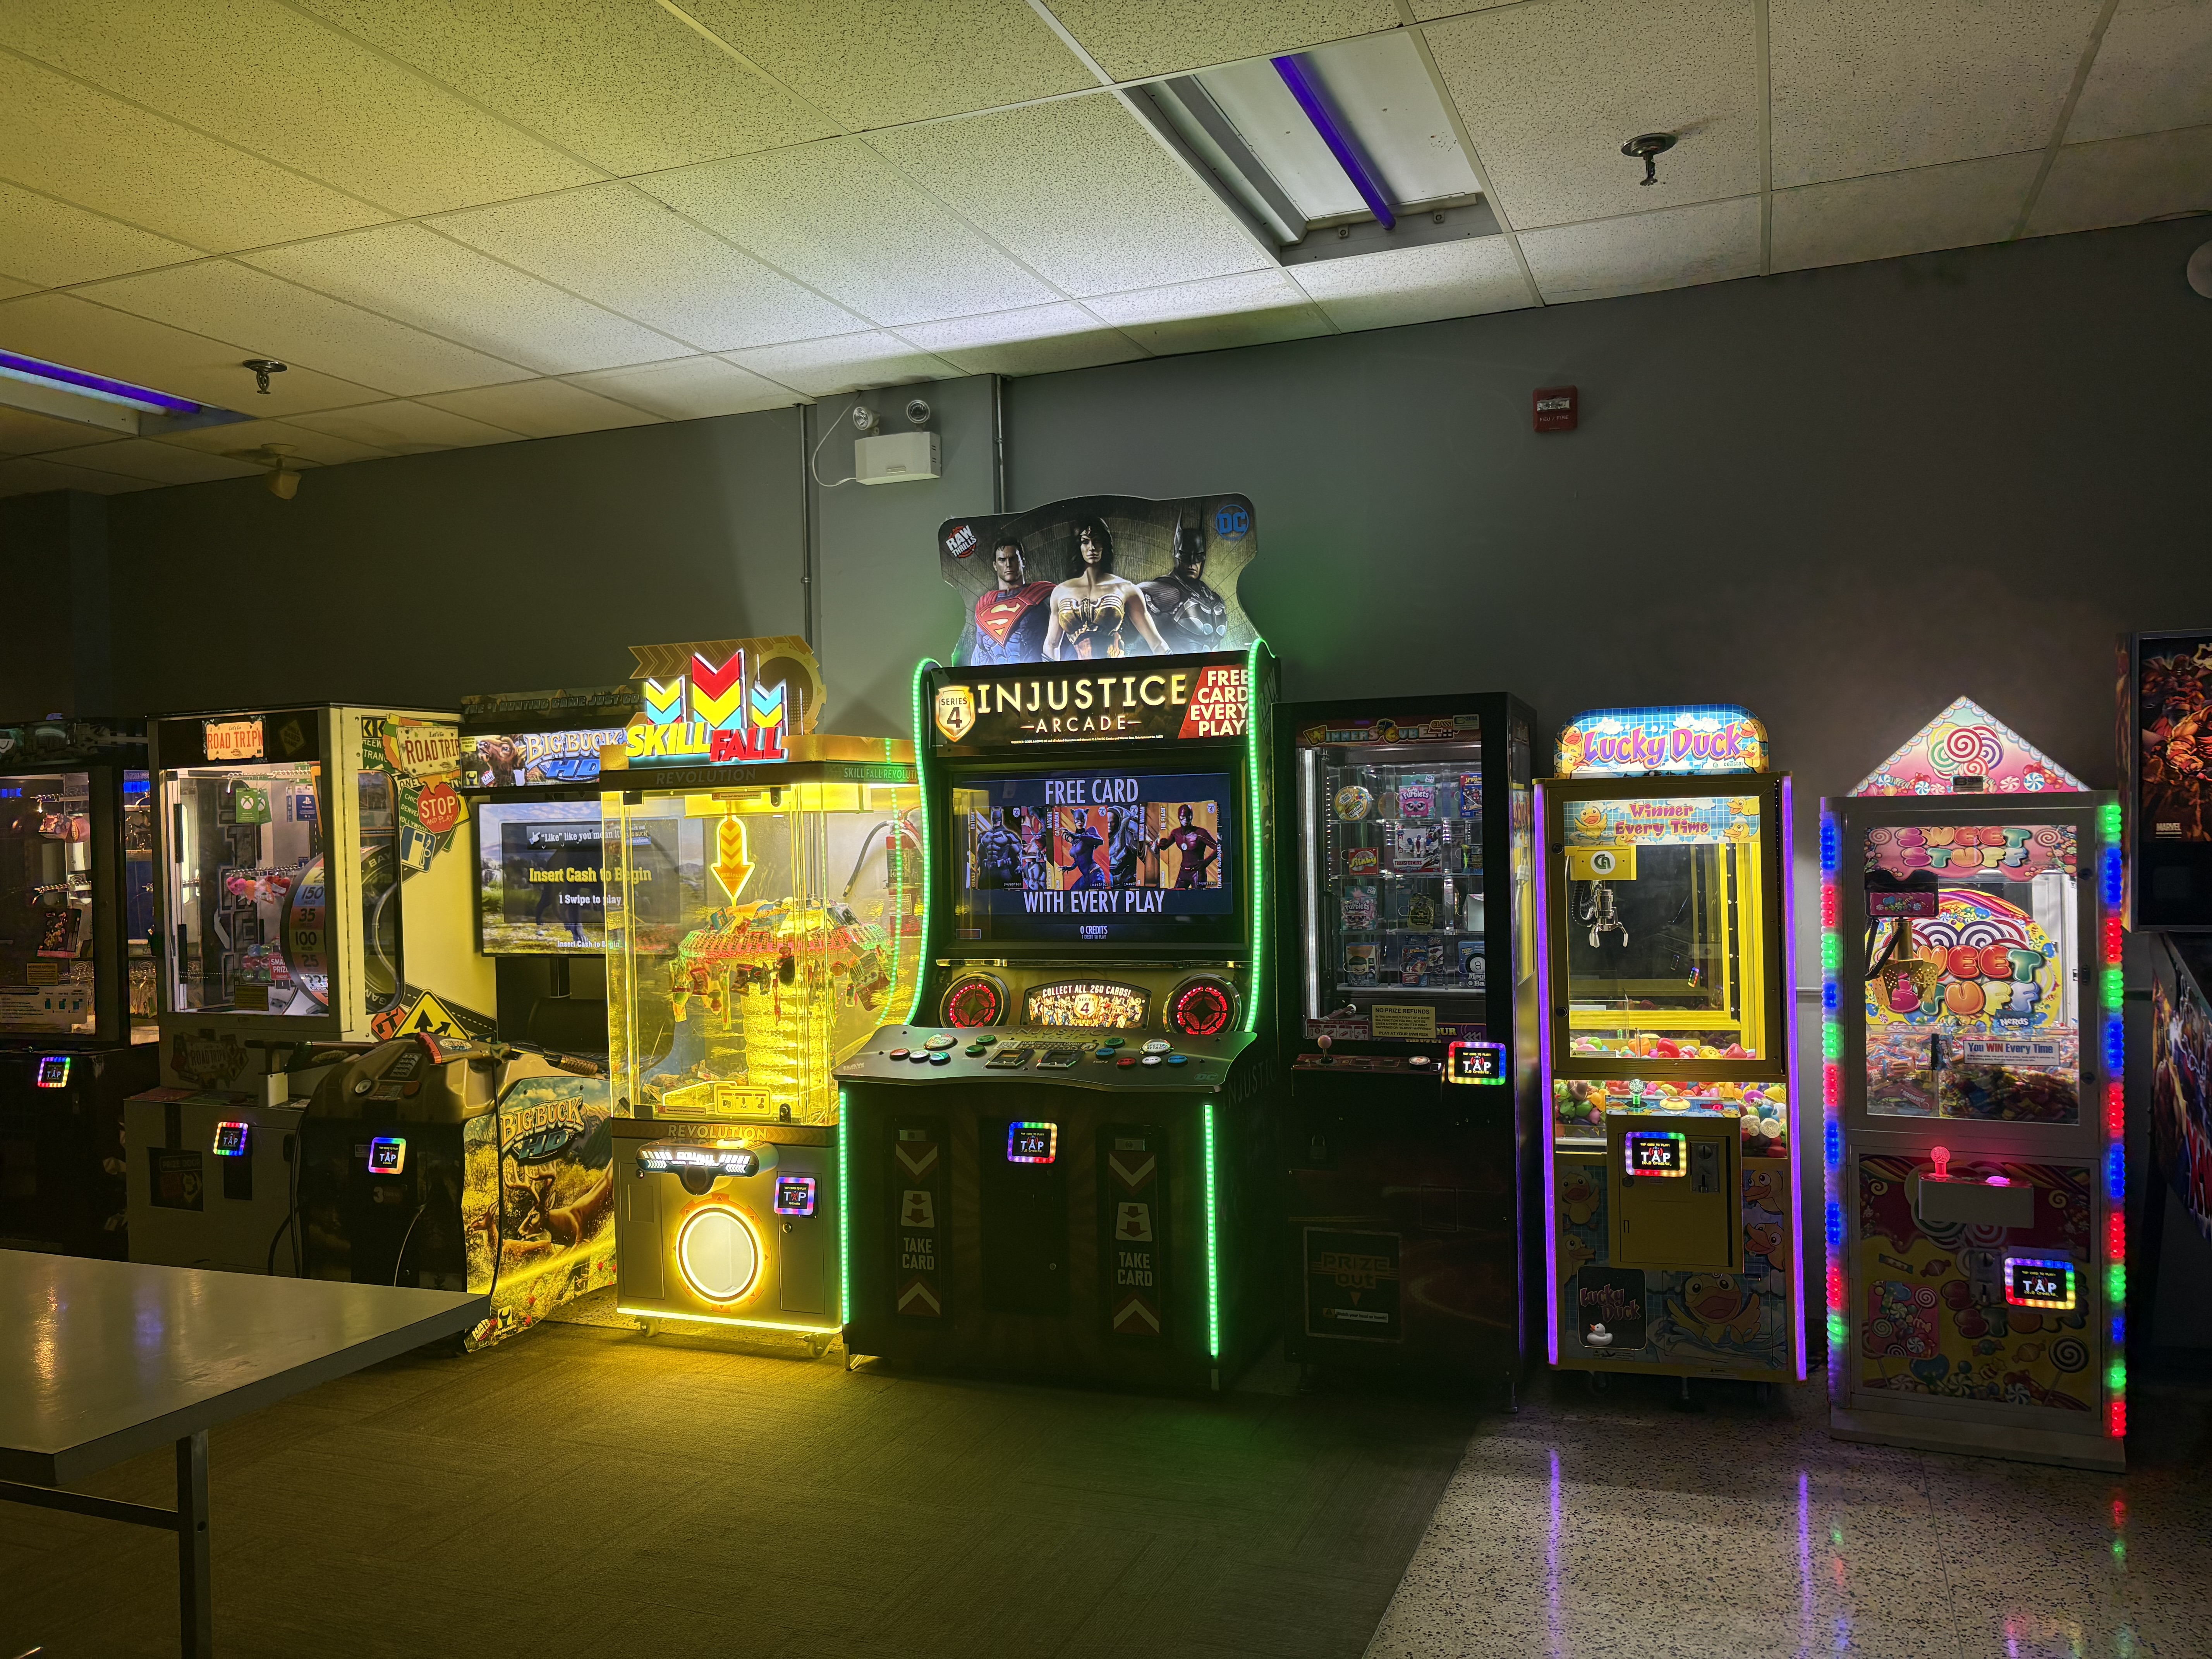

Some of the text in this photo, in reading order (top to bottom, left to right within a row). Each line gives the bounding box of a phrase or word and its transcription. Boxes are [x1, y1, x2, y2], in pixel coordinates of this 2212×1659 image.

[1216, 512, 1247, 534] DC
[946, 525, 973, 552] RAW
[951, 536, 977, 558] THRILLS
[1207, 669, 1249, 687] FREE
[941, 697, 967, 706] SERIES
[977, 673, 1188, 714] INJUSTICE
[1197, 687, 1249, 704] CARD
[499, 699, 550, 712] HUNTING
[551, 696, 586, 708] GAME
[588, 694, 620, 706] JUST
[947, 707, 962, 728] 4
[1191, 703, 1249, 721] EVERY
[1036, 714, 1126, 733] ARCADE
[1199, 720, 1249, 737] PLAY!
[207, 732, 231, 749] ROAD
[525, 732, 563, 765] BIG
[625, 722, 783, 762] SKILL FALL
[1583, 722, 1743, 768] Lucky Duck
[405, 739, 439, 765] ROAD
[545, 758, 601, 778] HD
[657, 768, 756, 785] REVOLUTION
[844, 767, 917, 779] SKILL FALL REVOLUTI
[1045, 778, 1139, 804] FREE CARD
[421, 796, 456, 819] STOP
[1629, 803, 1693, 819] Winner
[427, 814, 454, 825] AND PLAY
[1615, 818, 1710, 837] Every Time
[564, 832, 577, 841] like
[579, 832, 592, 842] you
[1895, 826, 2031, 848] SWEET
[369, 852, 391, 868] BAY
[1350, 856, 1377, 867] Slinky
[1900, 847, 2030, 869] STUFF
[529, 867, 565, 883] Insert
[566, 867, 597, 883] Cash
[301, 887, 324, 900] 150
[565, 895, 591, 905] Swipe
[592, 895, 601, 904] to
[1024, 890, 1165, 913] WITH EVERY PLAY
[299, 908, 315, 922] 35
[295, 931, 317, 946] 100
[1085, 926, 1108, 934] CREDITS
[302, 955, 319, 967] 25
[1475, 961, 1481, 970] 8
[1916, 944, 2044, 983] WEET
[1468, 972, 1486, 982] Magi
[1042, 985, 1132, 998] COLLECT ALL 260 CARDS!
[1080, 1002, 1090, 1014] 4
[1968, 1042, 2054, 1054] You WIN Every Time
[1463, 1059, 1491, 1071] TAP
[47, 1070, 61, 1078] TAP
[502, 1096, 584, 1147] BIG BUCK
[223, 1136, 238, 1145] TAP
[668, 1124, 768, 1140] REVOLUTION
[519, 1130, 568, 1159] HD
[1020, 1139, 1044, 1150] TAP
[380, 1152, 397, 1162] TAP
[1640, 1150, 1671, 1162] TAP
[784, 1191, 807, 1202] TAP
[903, 1237, 933, 1254] TAKE
[902, 1254, 935, 1270] CARD
[1119, 1252, 1151, 1269] TAKE
[1323, 1254, 1389, 1272] PRIZE
[1117, 1269, 1153, 1286] CARD
[2022, 1279, 2057, 1293] TAP
[1580, 1283, 1625, 1307] Lucky
[1601, 1299, 1642, 1323] Duck
